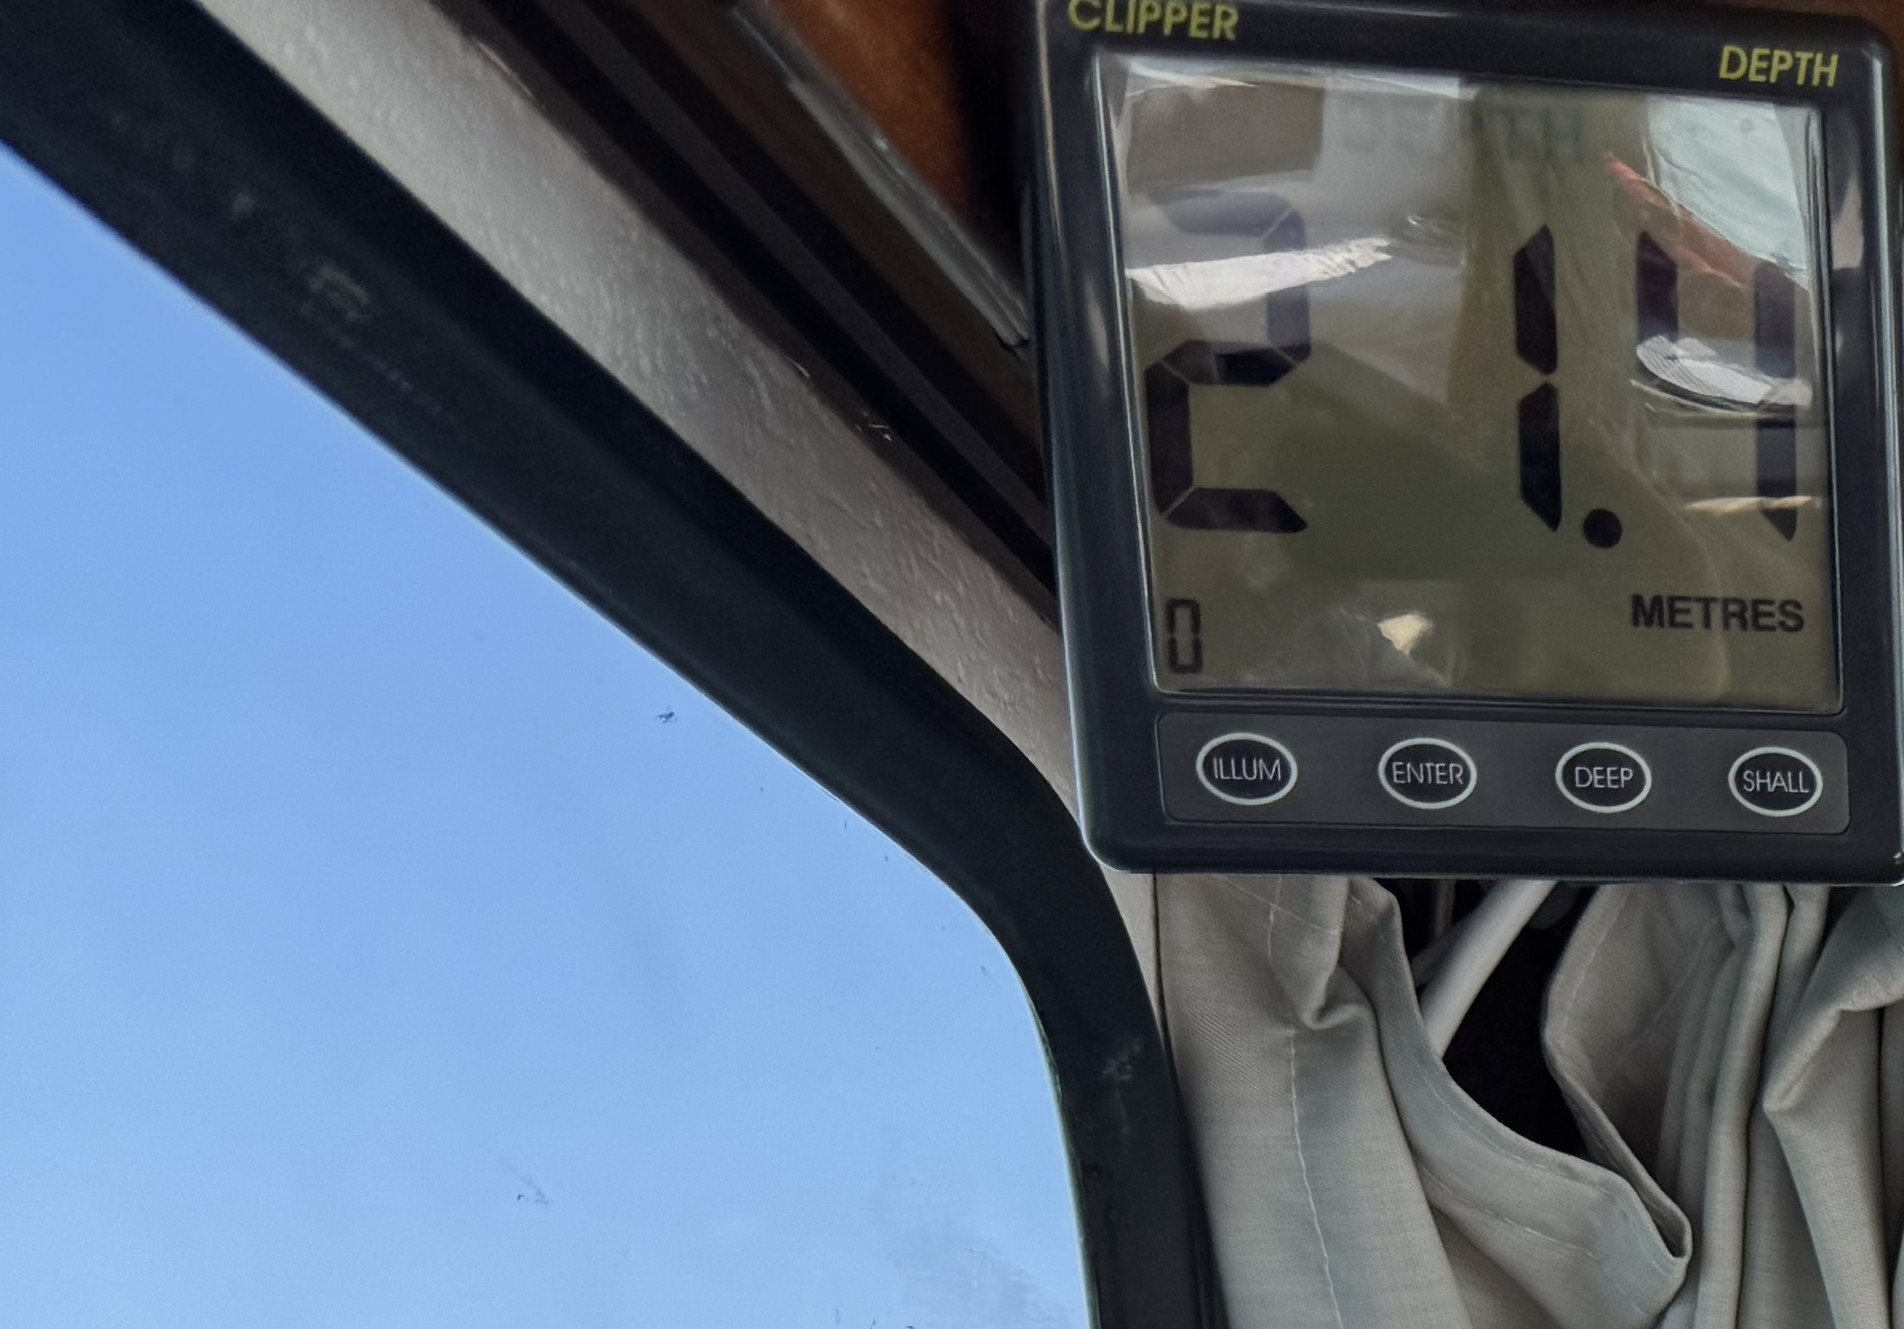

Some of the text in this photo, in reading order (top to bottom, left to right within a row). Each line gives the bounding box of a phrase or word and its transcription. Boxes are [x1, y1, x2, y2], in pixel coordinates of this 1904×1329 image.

[1066, 0, 1240, 40] CLIPPER
[1719, 45, 1840, 88] DEPTH
[1631, 593, 1806, 634] METRES
[1164, 600, 1203, 674] 0
[1211, 756, 1284, 785] ILLUM
[1391, 761, 1465, 788] ENTER
[1574, 764, 1634, 791] DEEP
[1743, 769, 1810, 797] SHALL
